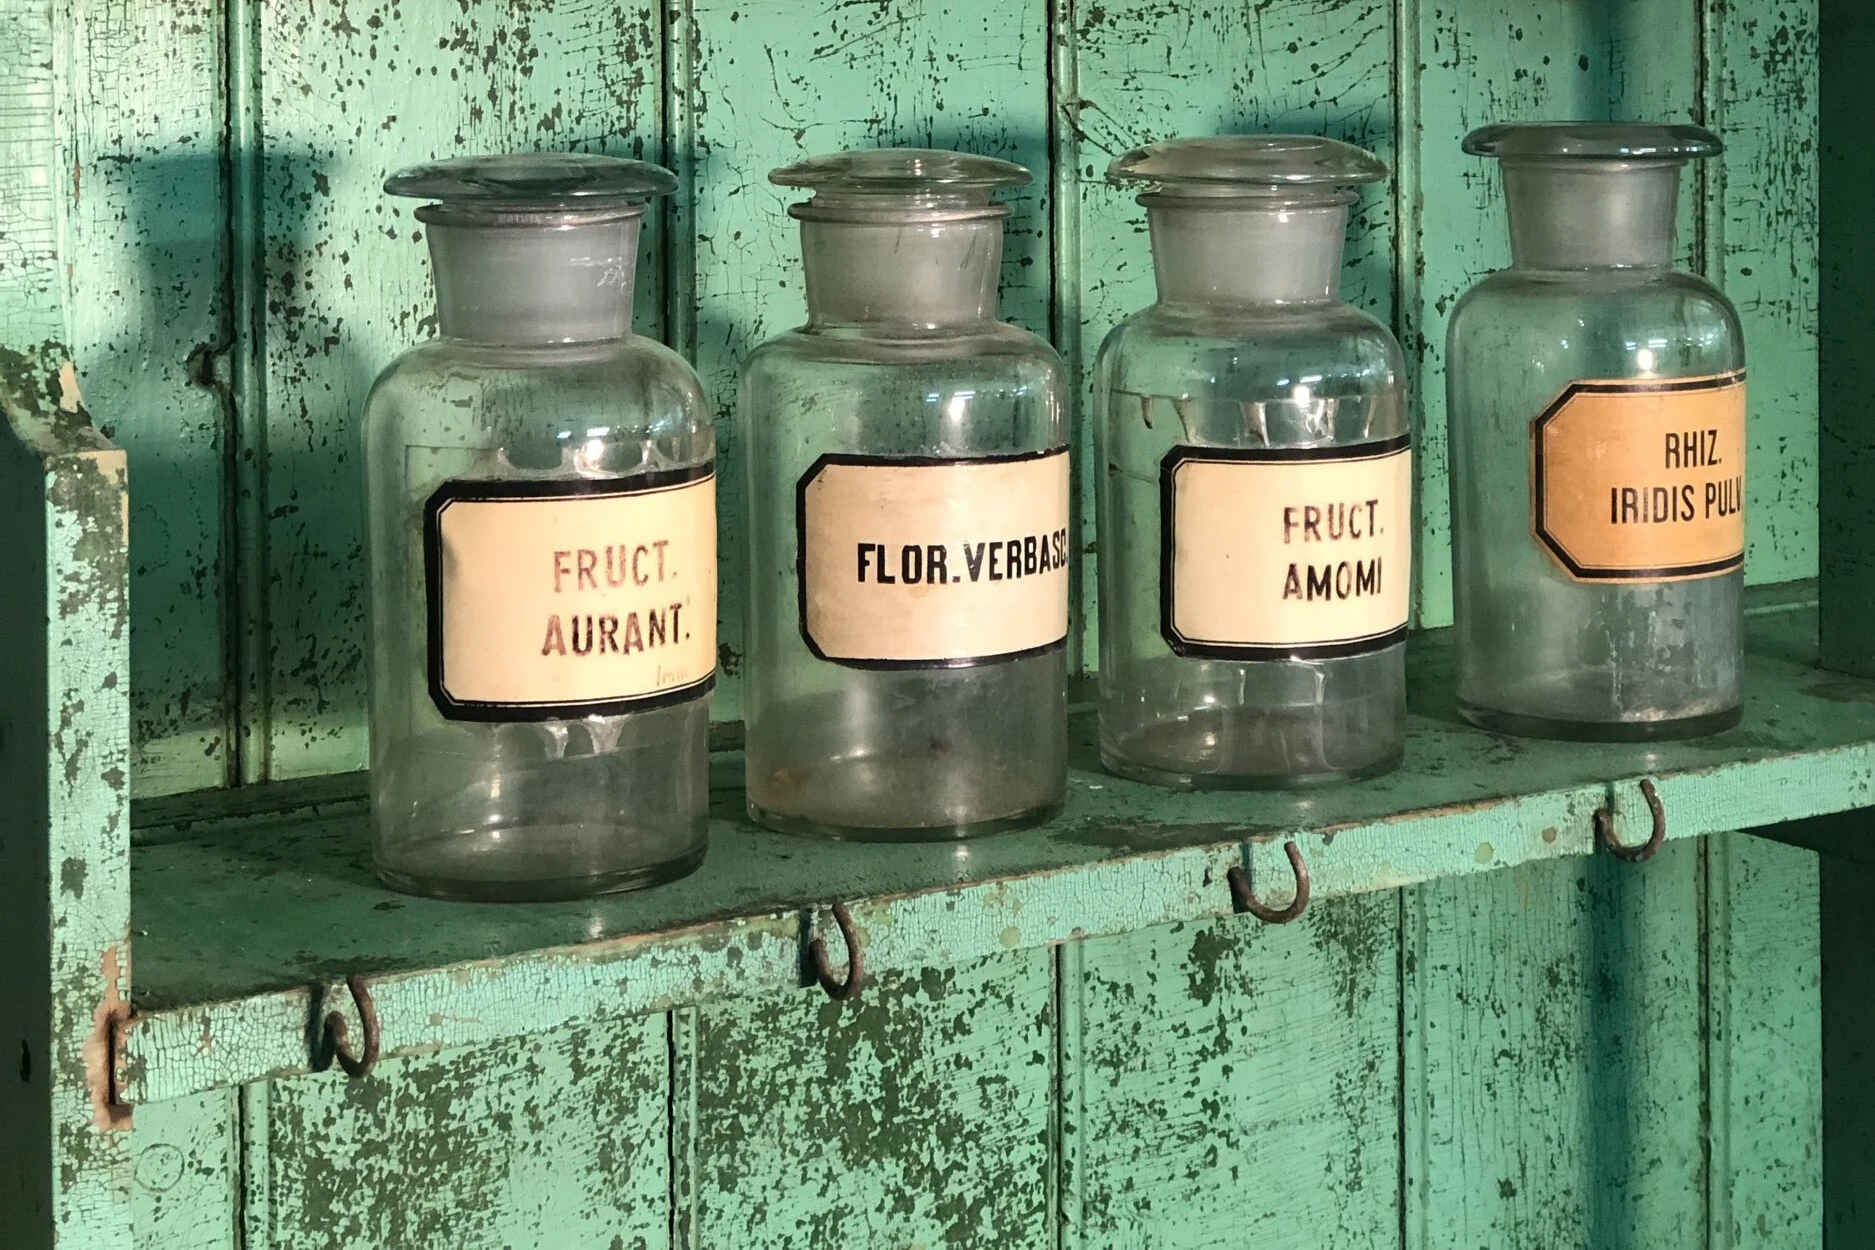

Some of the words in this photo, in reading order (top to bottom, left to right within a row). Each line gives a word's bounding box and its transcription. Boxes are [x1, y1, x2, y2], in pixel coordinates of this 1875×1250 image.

[1665, 429, 1722, 469] RHIZ.
[1283, 499, 1384, 545] FRUCT.
[1611, 485, 1695, 524] IRIDIS
[553, 540, 677, 593] FRUCT.
[1282, 556, 1383, 602] AMOMI
[541, 602, 691, 656] AURANT.
